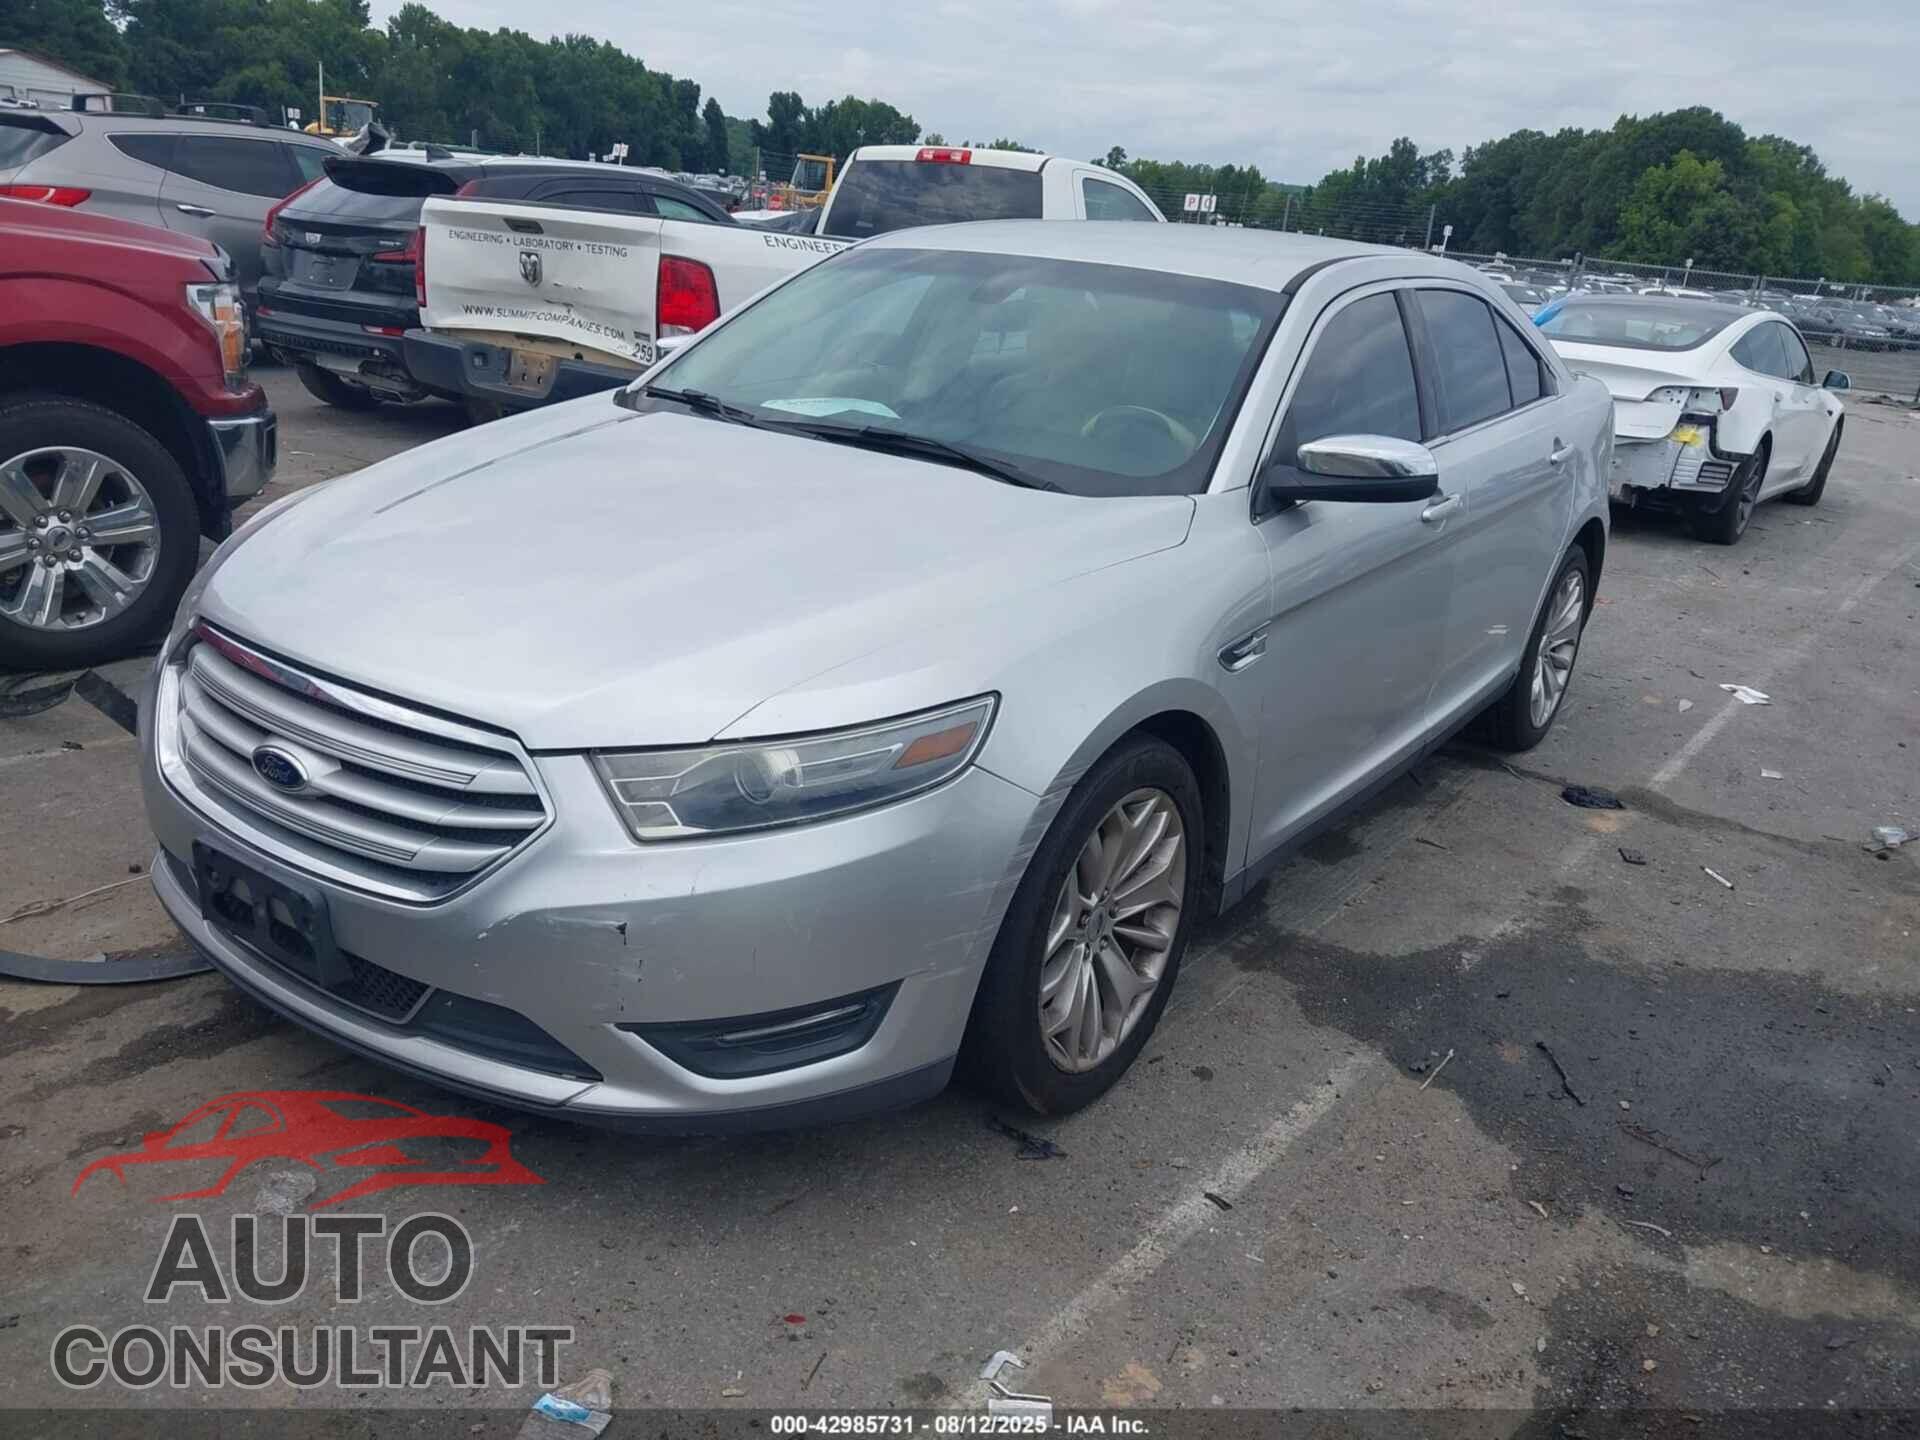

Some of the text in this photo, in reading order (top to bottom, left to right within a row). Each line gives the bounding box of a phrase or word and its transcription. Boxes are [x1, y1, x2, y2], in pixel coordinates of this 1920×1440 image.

[449, 230, 628, 258] ENGINEERING LABORATORY TESTING
[632, 342, 653, 362] 259
